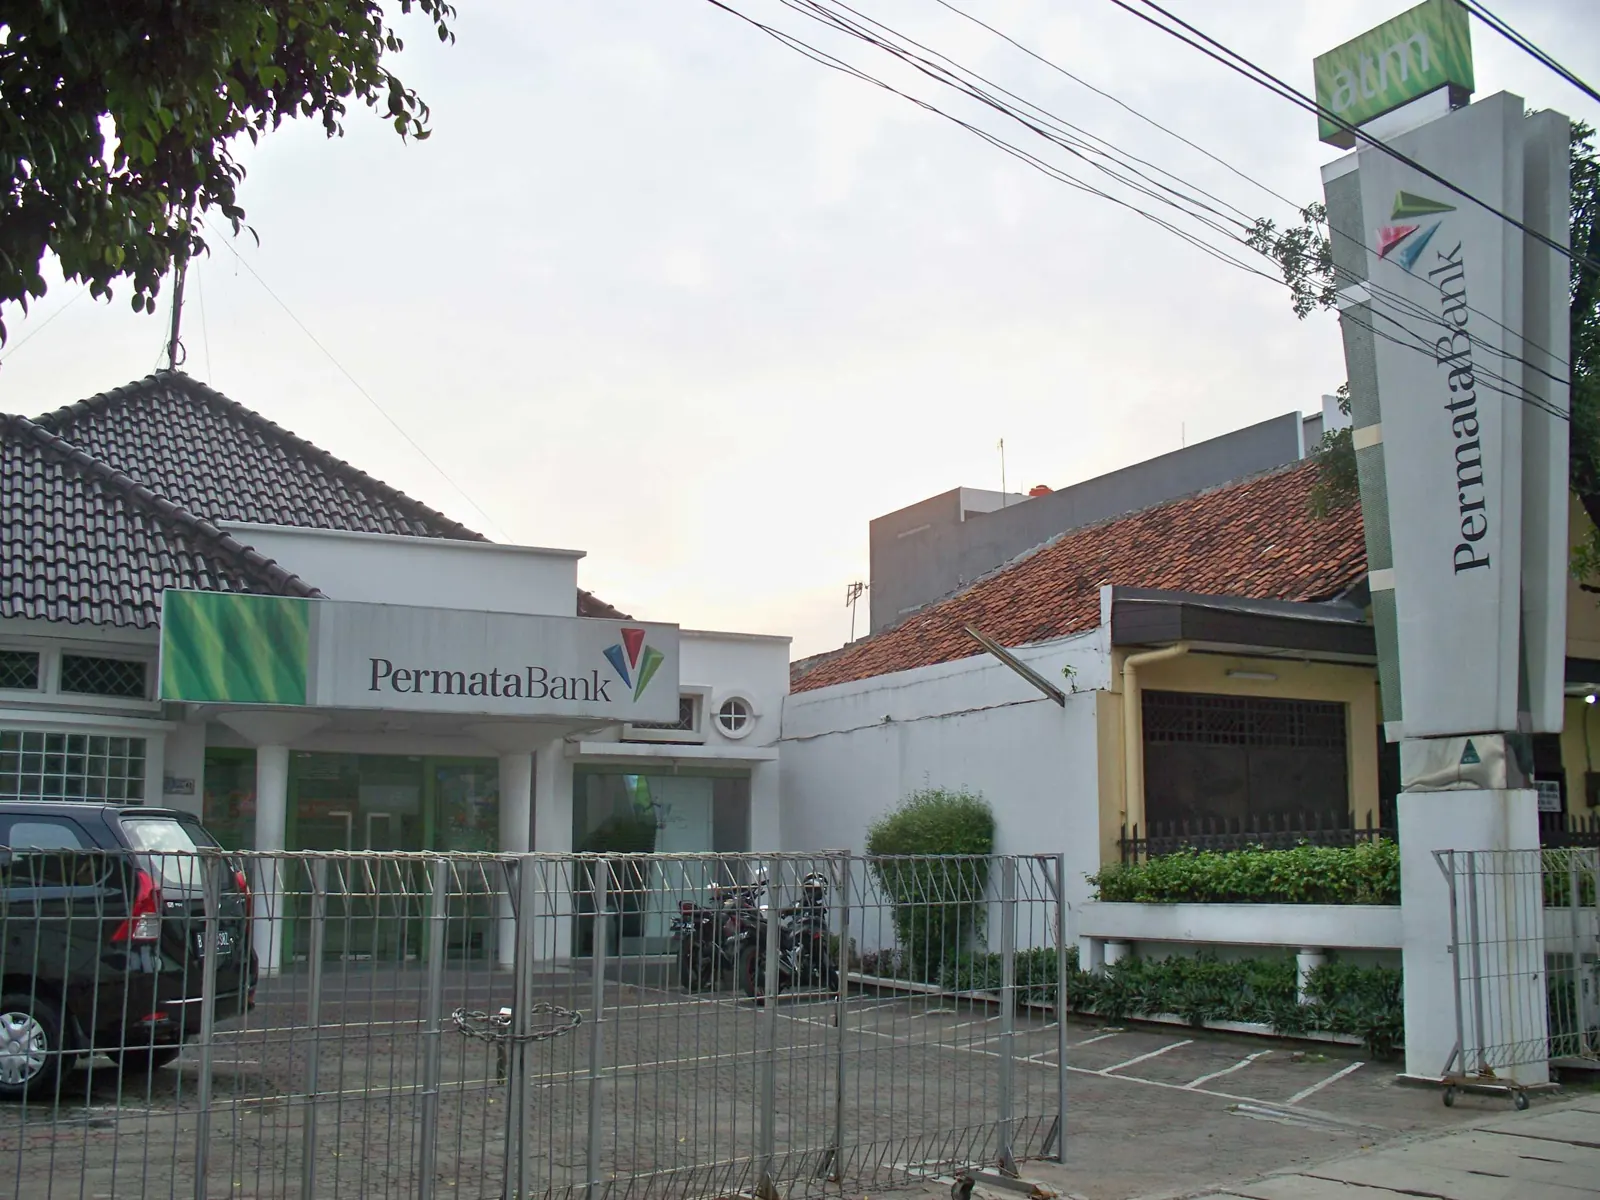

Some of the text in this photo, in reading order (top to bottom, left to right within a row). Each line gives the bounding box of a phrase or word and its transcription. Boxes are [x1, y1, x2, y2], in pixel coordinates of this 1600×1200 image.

[1332, 31, 1430, 113] atm
[1428, 240, 1491, 575] PermataBank
[368, 658, 612, 702] PermataBank
